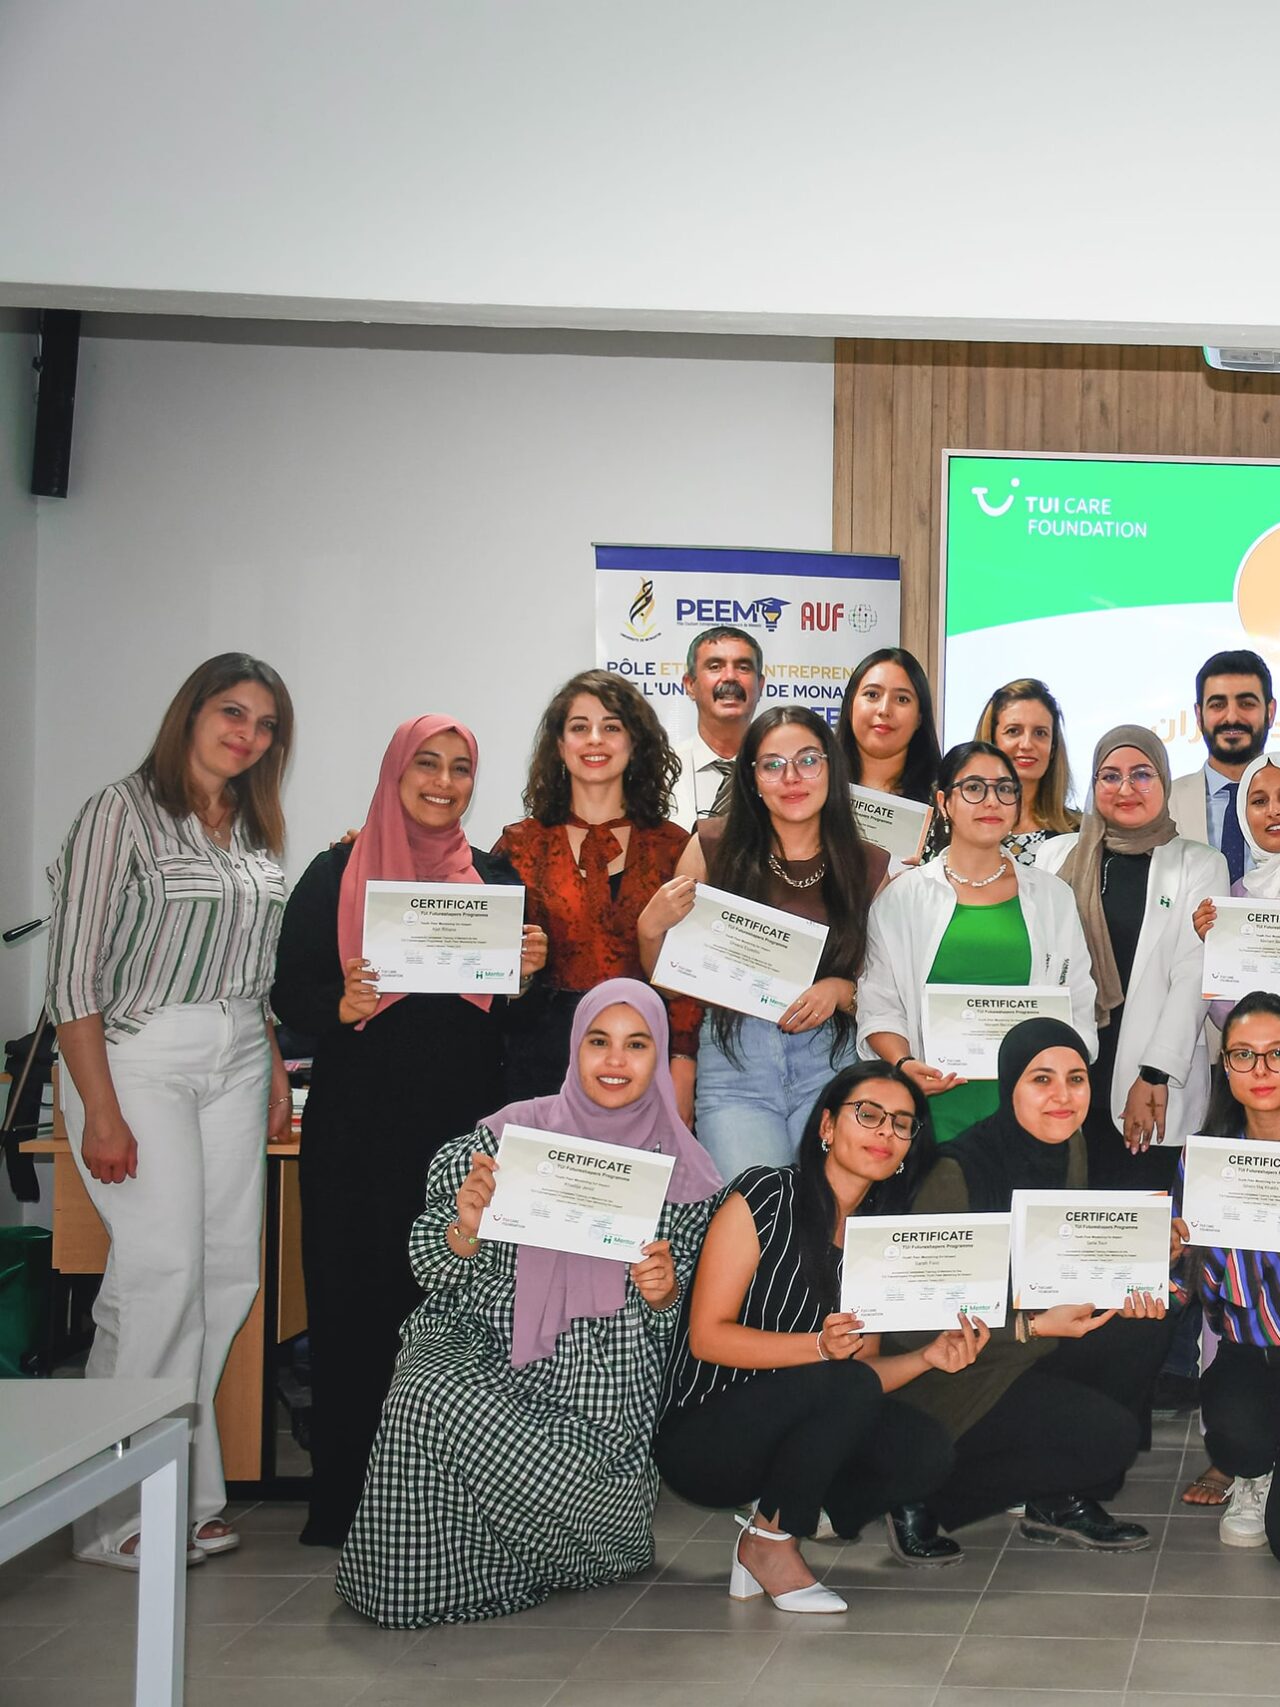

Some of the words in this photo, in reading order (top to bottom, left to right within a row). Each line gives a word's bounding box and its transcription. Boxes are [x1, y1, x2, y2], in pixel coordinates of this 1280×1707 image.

[1025, 496, 1059, 514] TUI
[1064, 498, 1112, 515] CARE
[1028, 519, 1147, 538] FOUNDATION
[676, 599, 757, 622] PEEM
[800, 601, 844, 632] AUF
[607, 658, 656, 675] PÔLE
[765, 664, 855, 680] NTREPREN
[643, 682, 687, 696] L'UN
[766, 685, 789, 698] DE
[794, 685, 845, 699] MONA
[851, 799, 895, 819] TIFICATE
[411, 899, 488, 910] CERTIFICATE
[721, 911, 790, 942] CERTIFICATE
[967, 999, 1038, 1009] CERTIFICATE
[548, 1150, 632, 1174] CERTIFICATE
[1066, 1212, 1137, 1222] CERTIFICATE
[892, 1231, 973, 1242] CERTIFICATE
